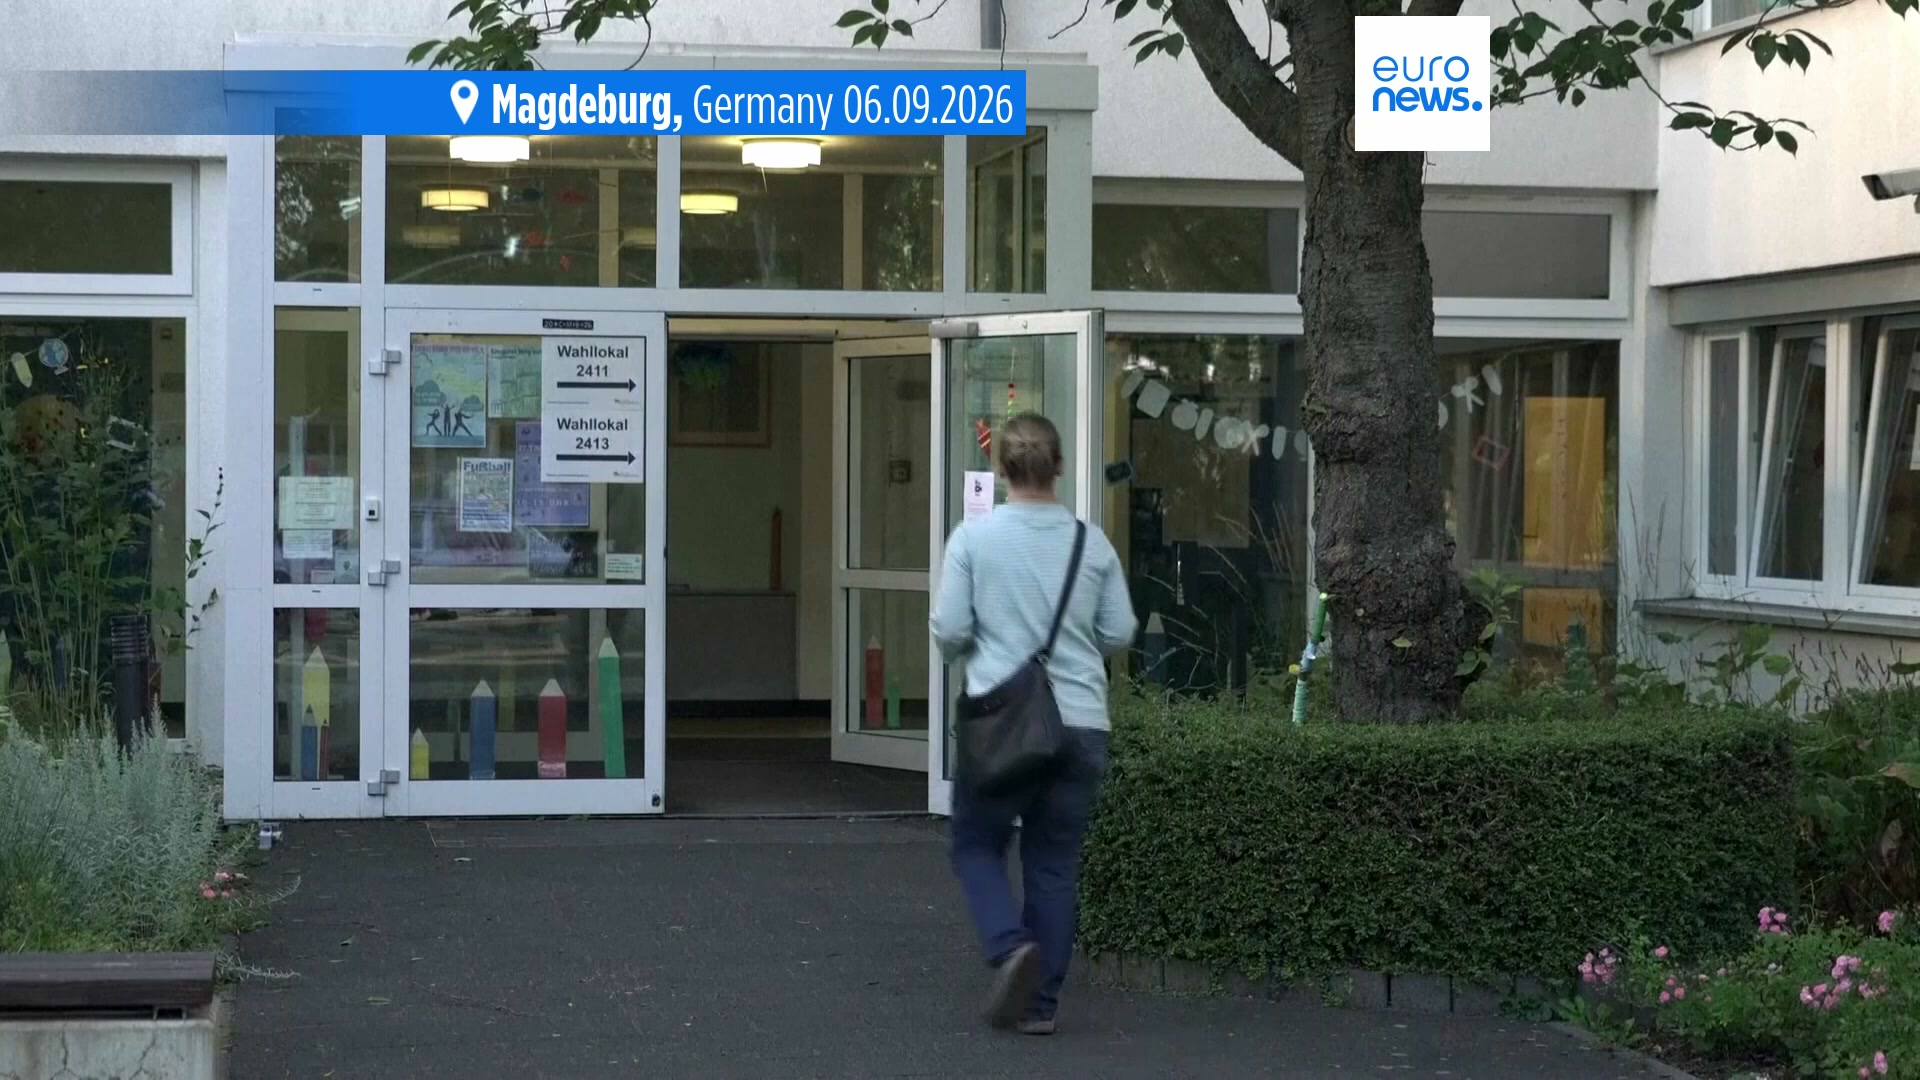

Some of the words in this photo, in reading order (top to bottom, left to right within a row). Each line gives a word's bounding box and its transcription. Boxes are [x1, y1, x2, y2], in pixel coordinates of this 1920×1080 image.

[557, 345, 629, 359] Wahllokal
[576, 364, 609, 377] 2411
[557, 417, 628, 431] Wahllokal
[575, 437, 609, 450] 2413
[464, 461, 511, 473] Fußball
